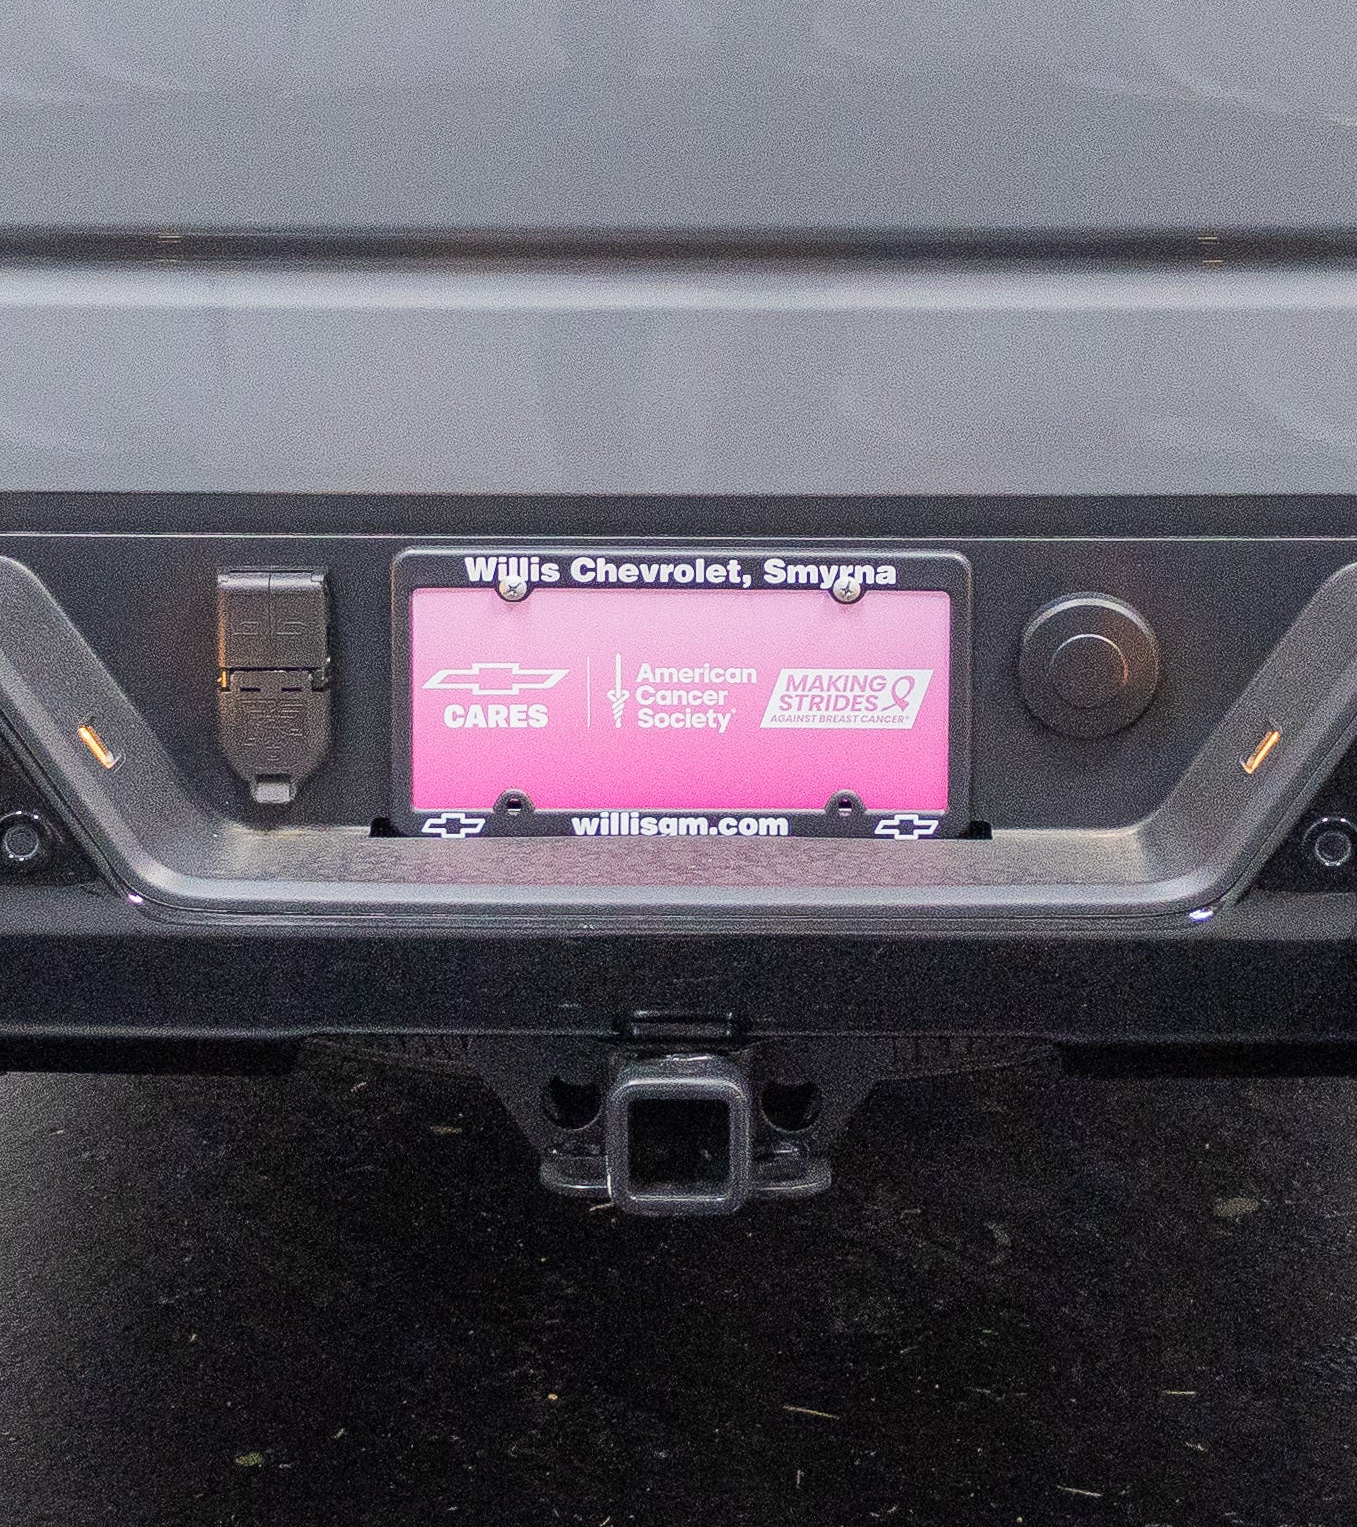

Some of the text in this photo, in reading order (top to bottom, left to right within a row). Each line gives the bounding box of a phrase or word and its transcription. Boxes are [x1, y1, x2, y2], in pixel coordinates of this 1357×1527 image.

[464, 556, 897, 588] Willis Chevrolet, Smyrna
[636, 662, 757, 684] American
[785, 674, 888, 693] MAKING
[635, 685, 729, 706] Cancer
[778, 694, 879, 712] STRIDES
[443, 703, 549, 728] CARES
[637, 707, 733, 734] Society
[771, 714, 906, 724] AGAINST BREAST CANCER
[571, 810, 789, 837] willisgm.com
